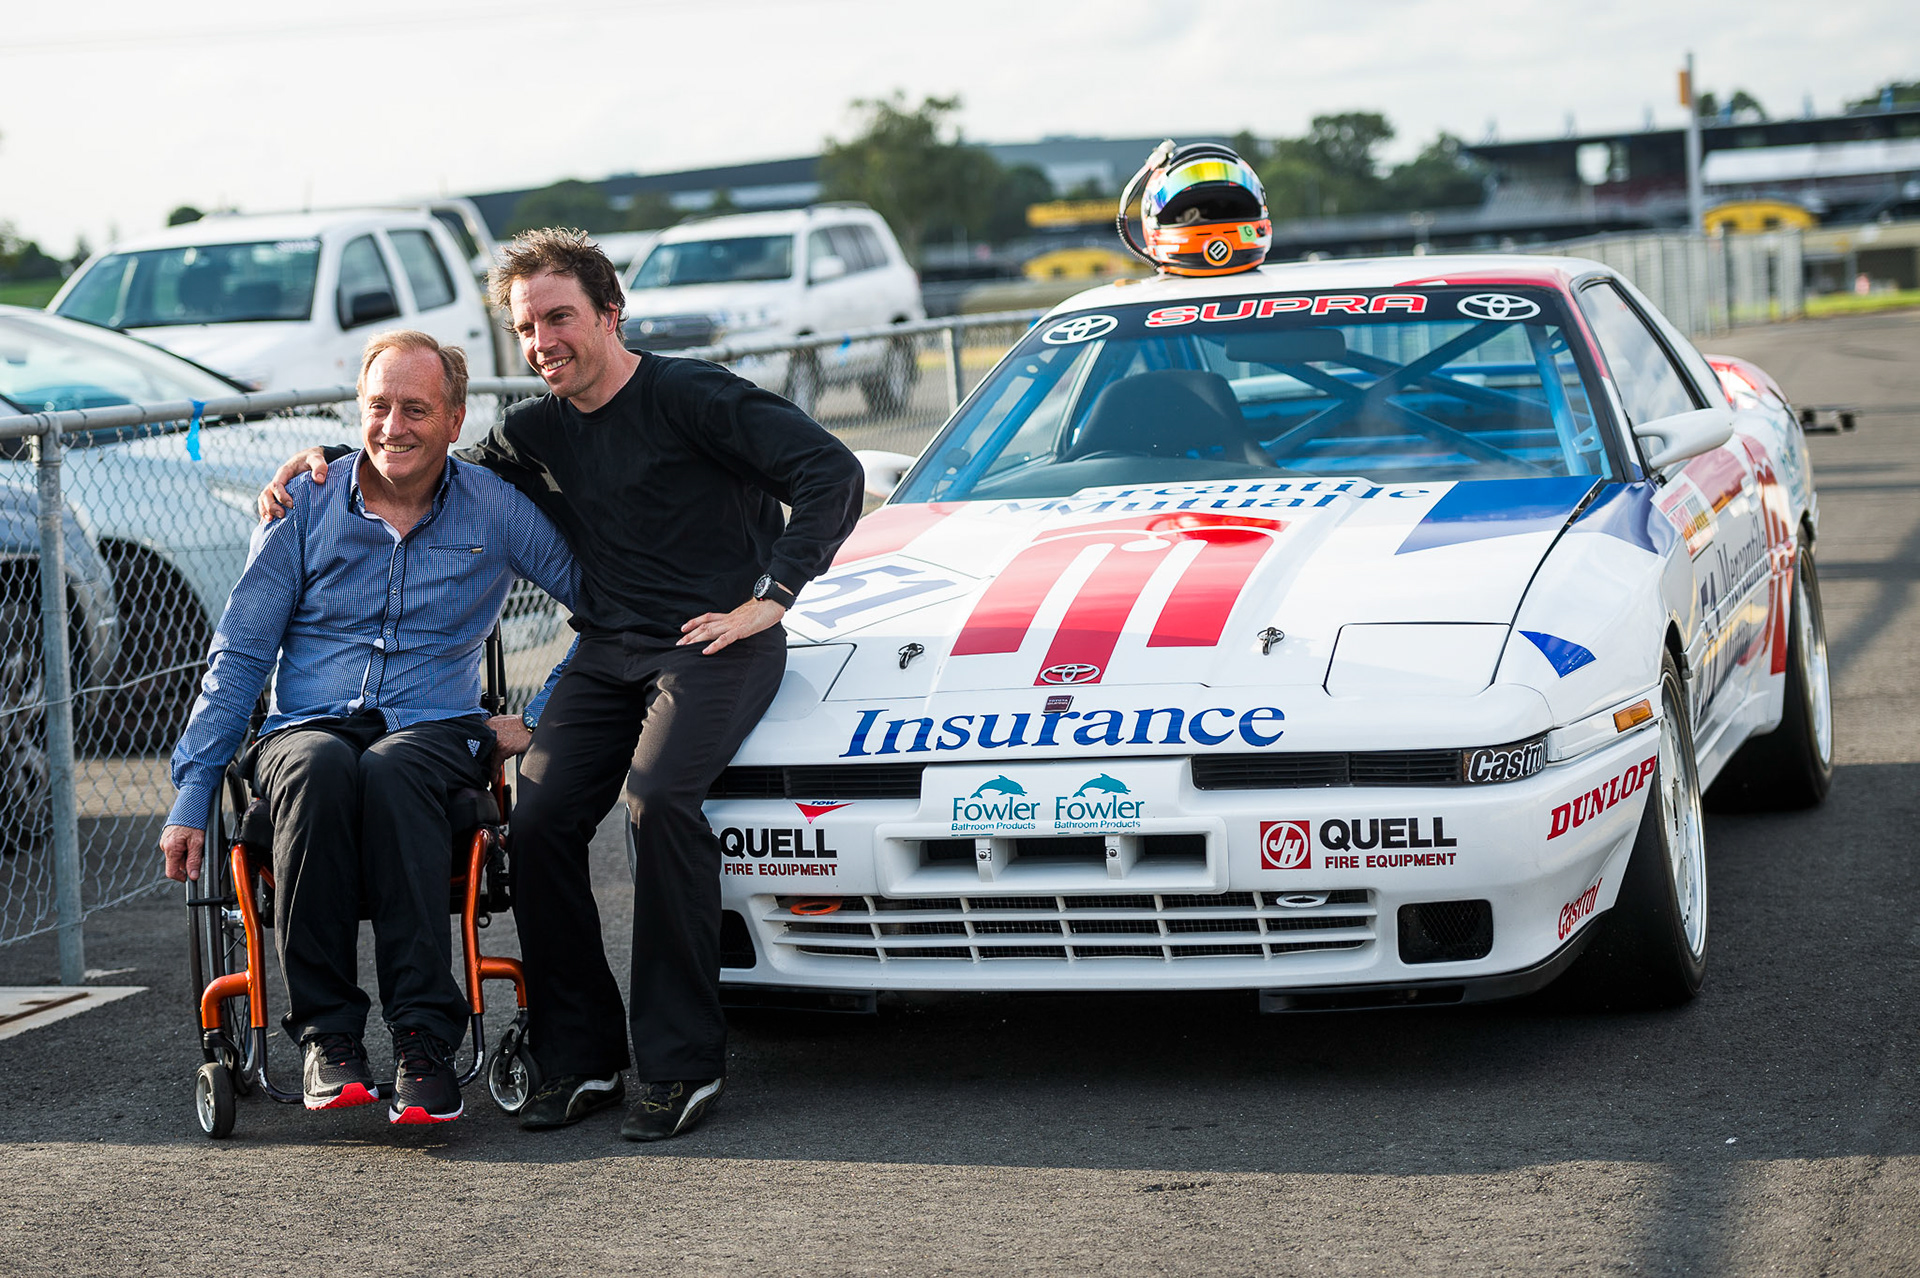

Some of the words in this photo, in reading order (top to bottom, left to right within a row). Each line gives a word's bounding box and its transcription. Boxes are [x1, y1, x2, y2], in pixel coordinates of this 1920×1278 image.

[1145, 294, 1428, 328] SUPRA
[986, 480, 1430, 515] Mercantile
[1049, 494, 1339, 516] Mutual
[839, 705, 1285, 758] Insurance
[1468, 736, 1547, 783] Castrol
[953, 796, 1040, 821] Fowler
[1055, 794, 1144, 819] Fowler
[1547, 755, 1657, 840] DUNLOP
[951, 822, 994, 831] Bathroom
[996, 821, 1036, 830] Products
[1054, 820, 1099, 829] Bathroom
[1100, 819, 1141, 828] Products
[1319, 817, 1458, 852] QUELL
[719, 827, 838, 860] QUELL
[724, 863, 754, 875] FIRE
[758, 863, 838, 876] EQUIPMENT
[1325, 856, 1360, 868] FIRE
[1366, 853, 1457, 867] EQUIPMENT
[1558, 877, 1603, 940] Castrol
